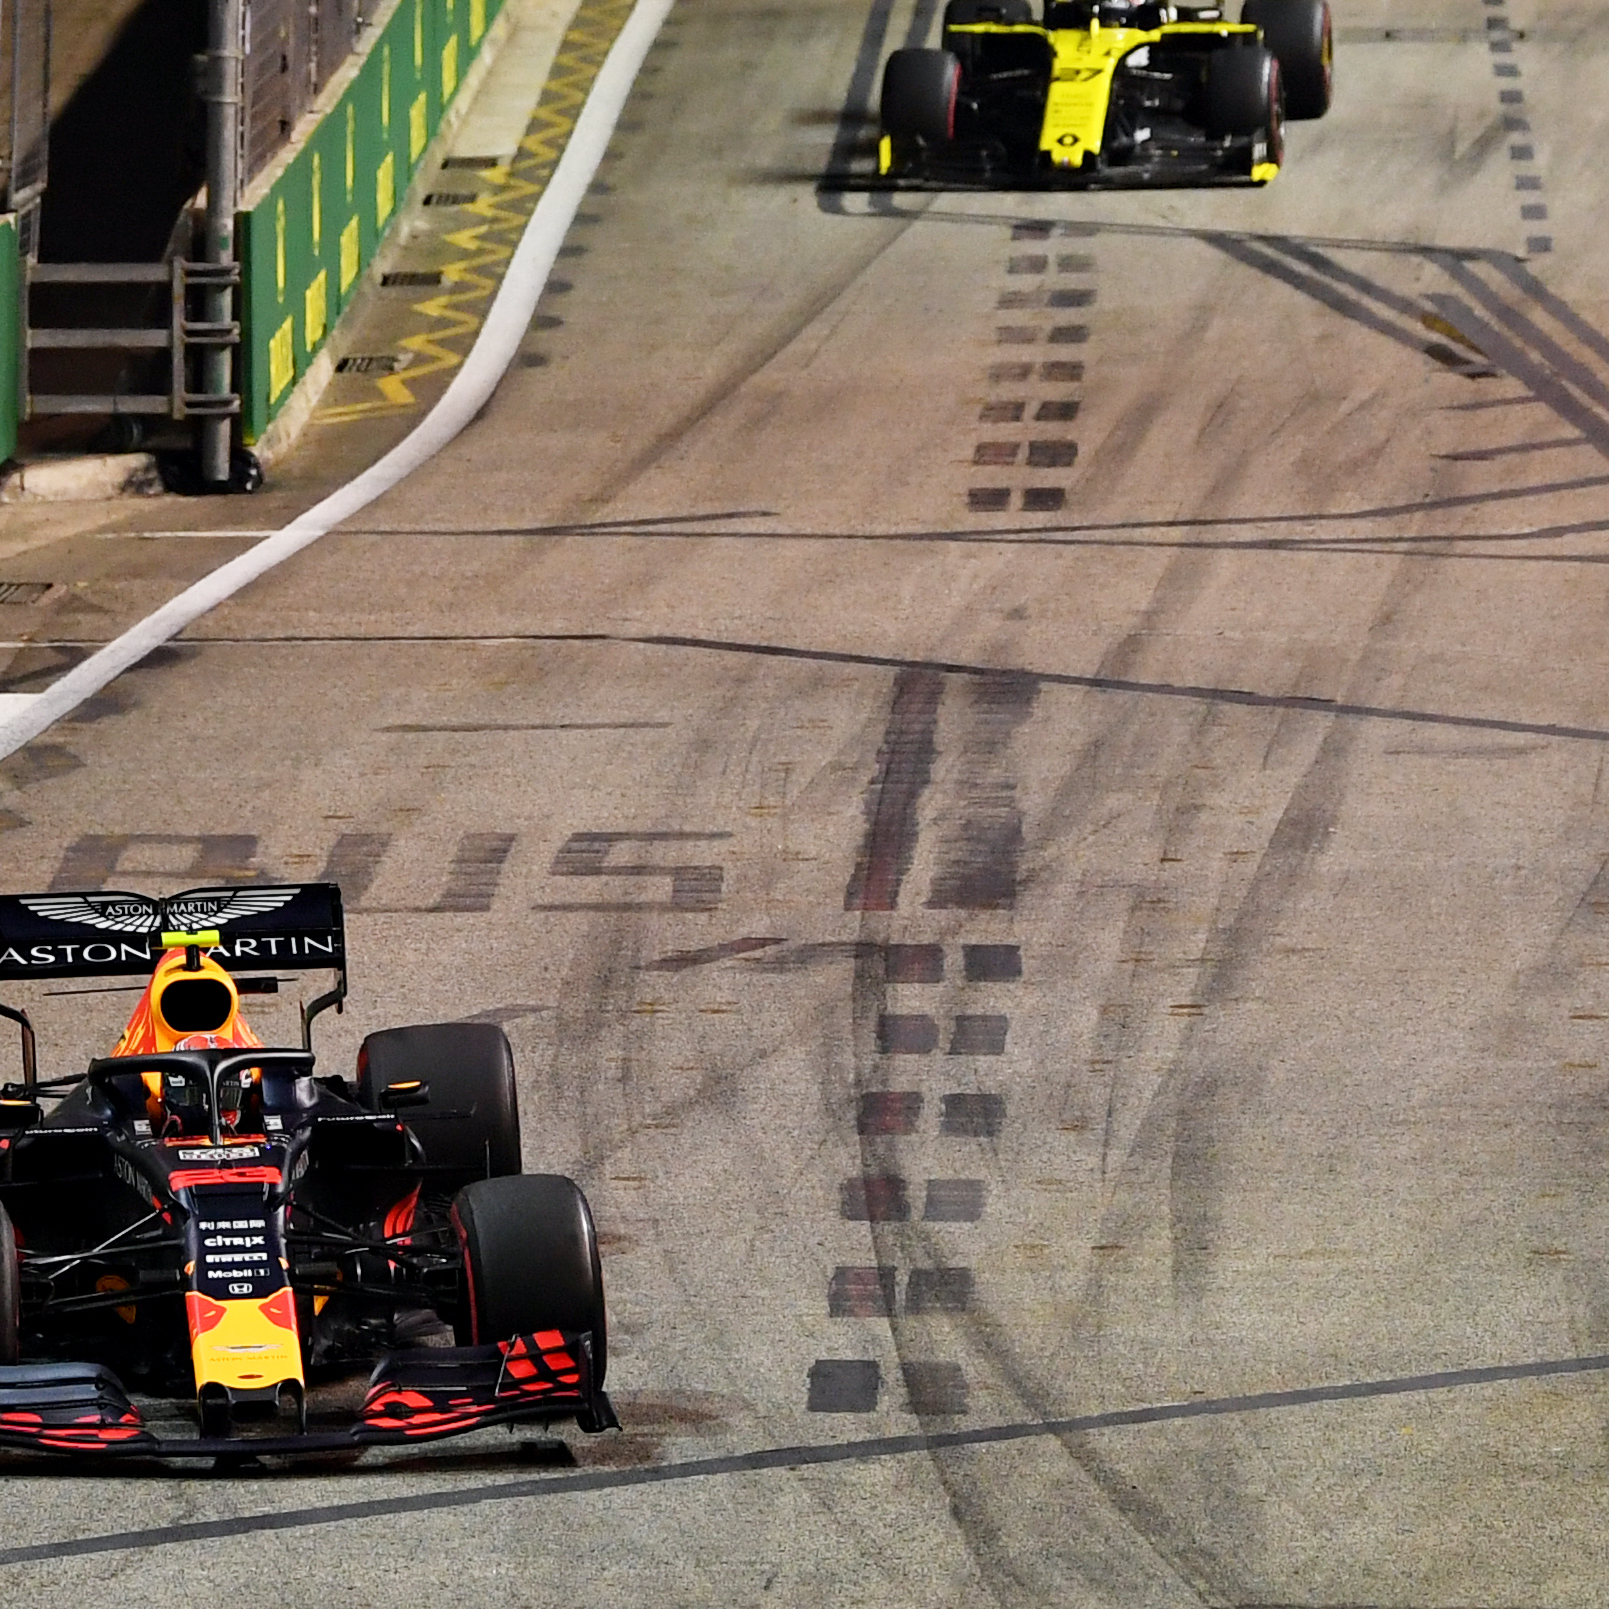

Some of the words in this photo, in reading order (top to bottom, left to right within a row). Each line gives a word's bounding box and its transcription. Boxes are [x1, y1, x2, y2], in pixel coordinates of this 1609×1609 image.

[105, 903, 153, 917] ASTON
[166, 900, 219, 915] MARTIN
[205, 935, 334, 958] ARTIN
[207, 1269, 253, 1279] Mobil
